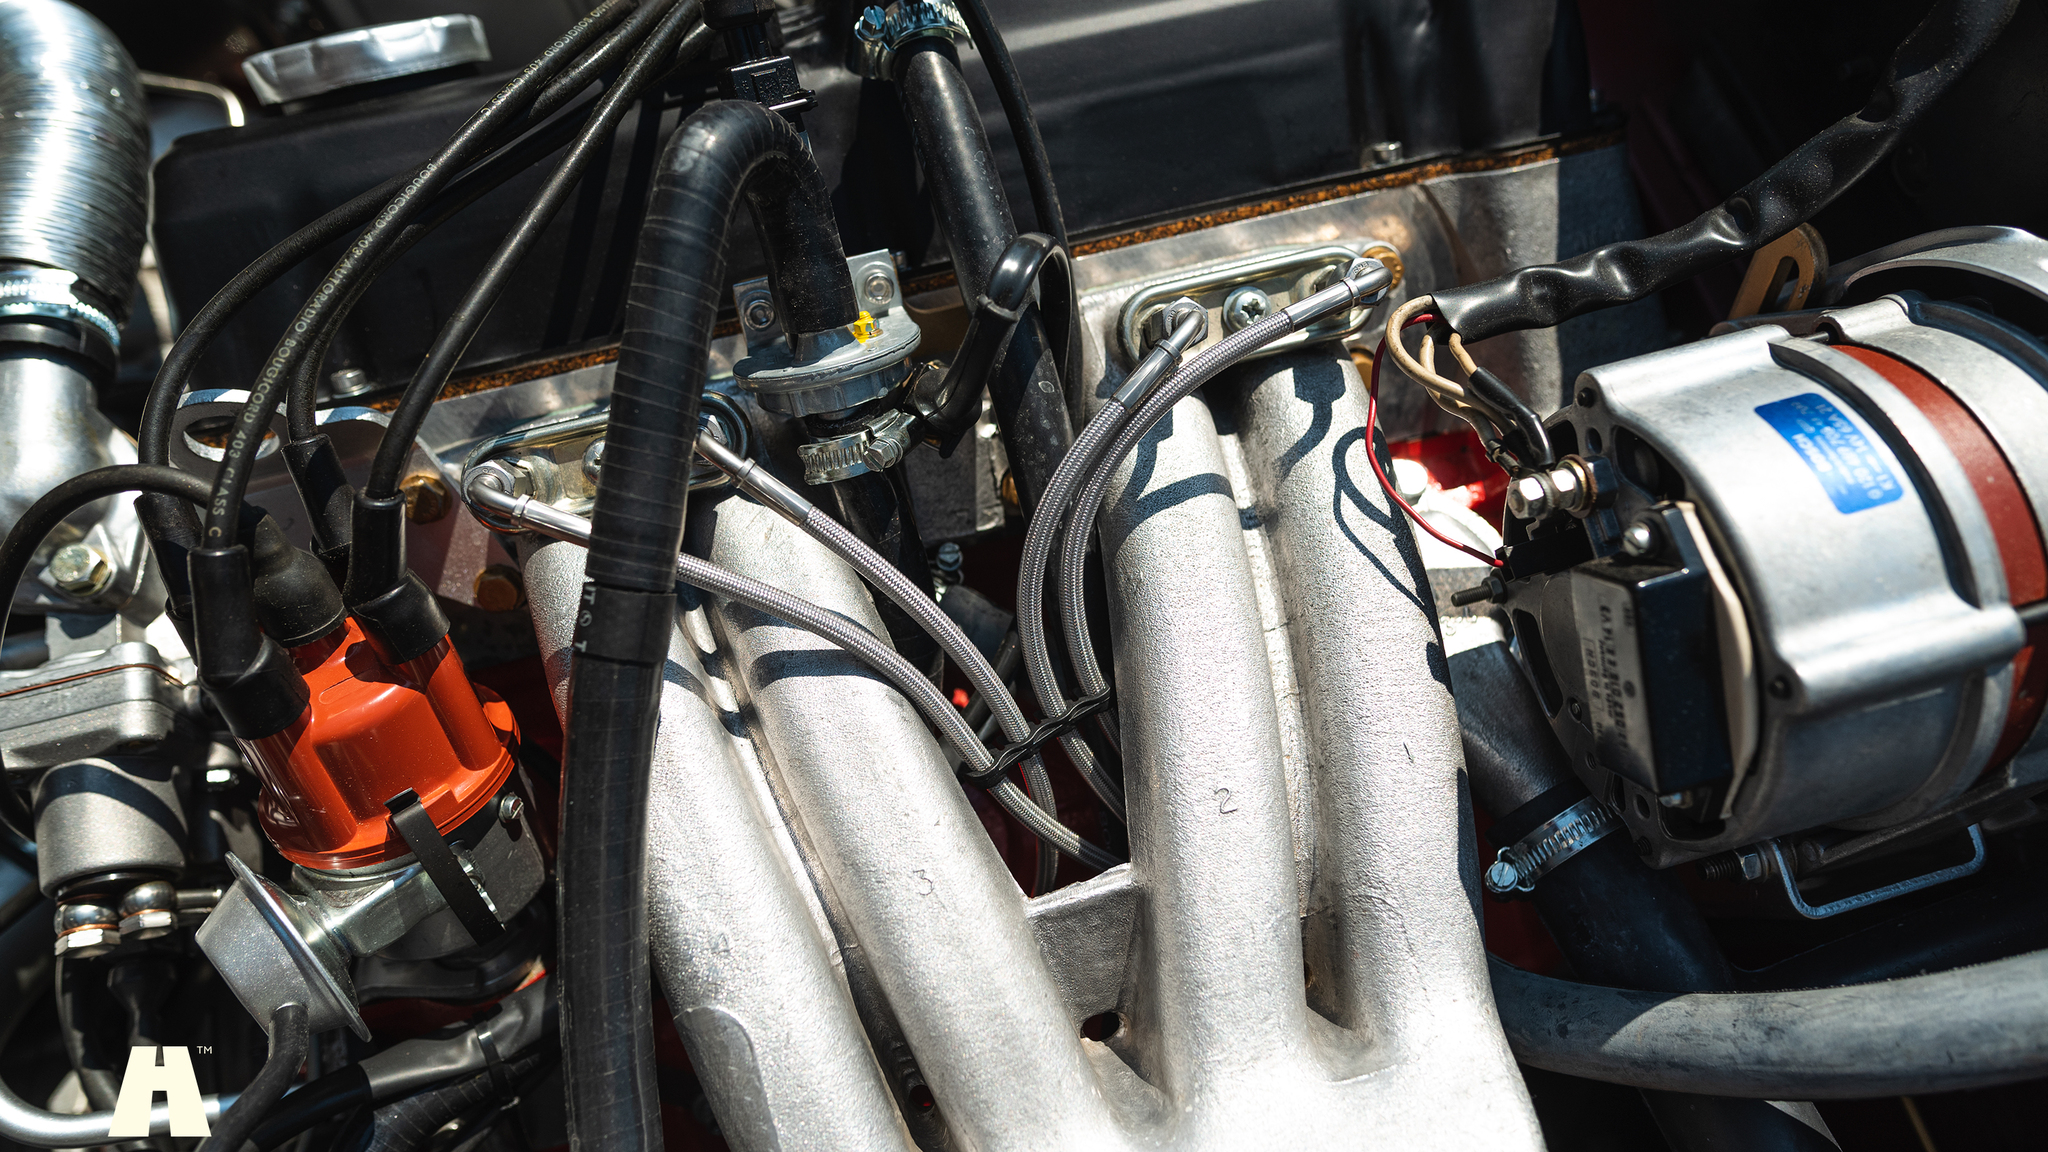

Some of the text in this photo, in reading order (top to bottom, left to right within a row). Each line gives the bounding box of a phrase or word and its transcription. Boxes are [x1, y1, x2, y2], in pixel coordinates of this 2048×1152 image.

[491, 77, 525, 106] CLASS
[375, 163, 438, 229] BOUGICORD
[352, 232, 374, 257] 403
[295, 258, 353, 333] AUTORADIO
[243, 338, 298, 424] BOUGICORD
[228, 429, 248, 459] 403
[212, 467, 235, 517] CLASS
[208, 526, 223, 538] C
[1213, 787, 1238, 814] 2
[912, 868, 934, 897] 3
